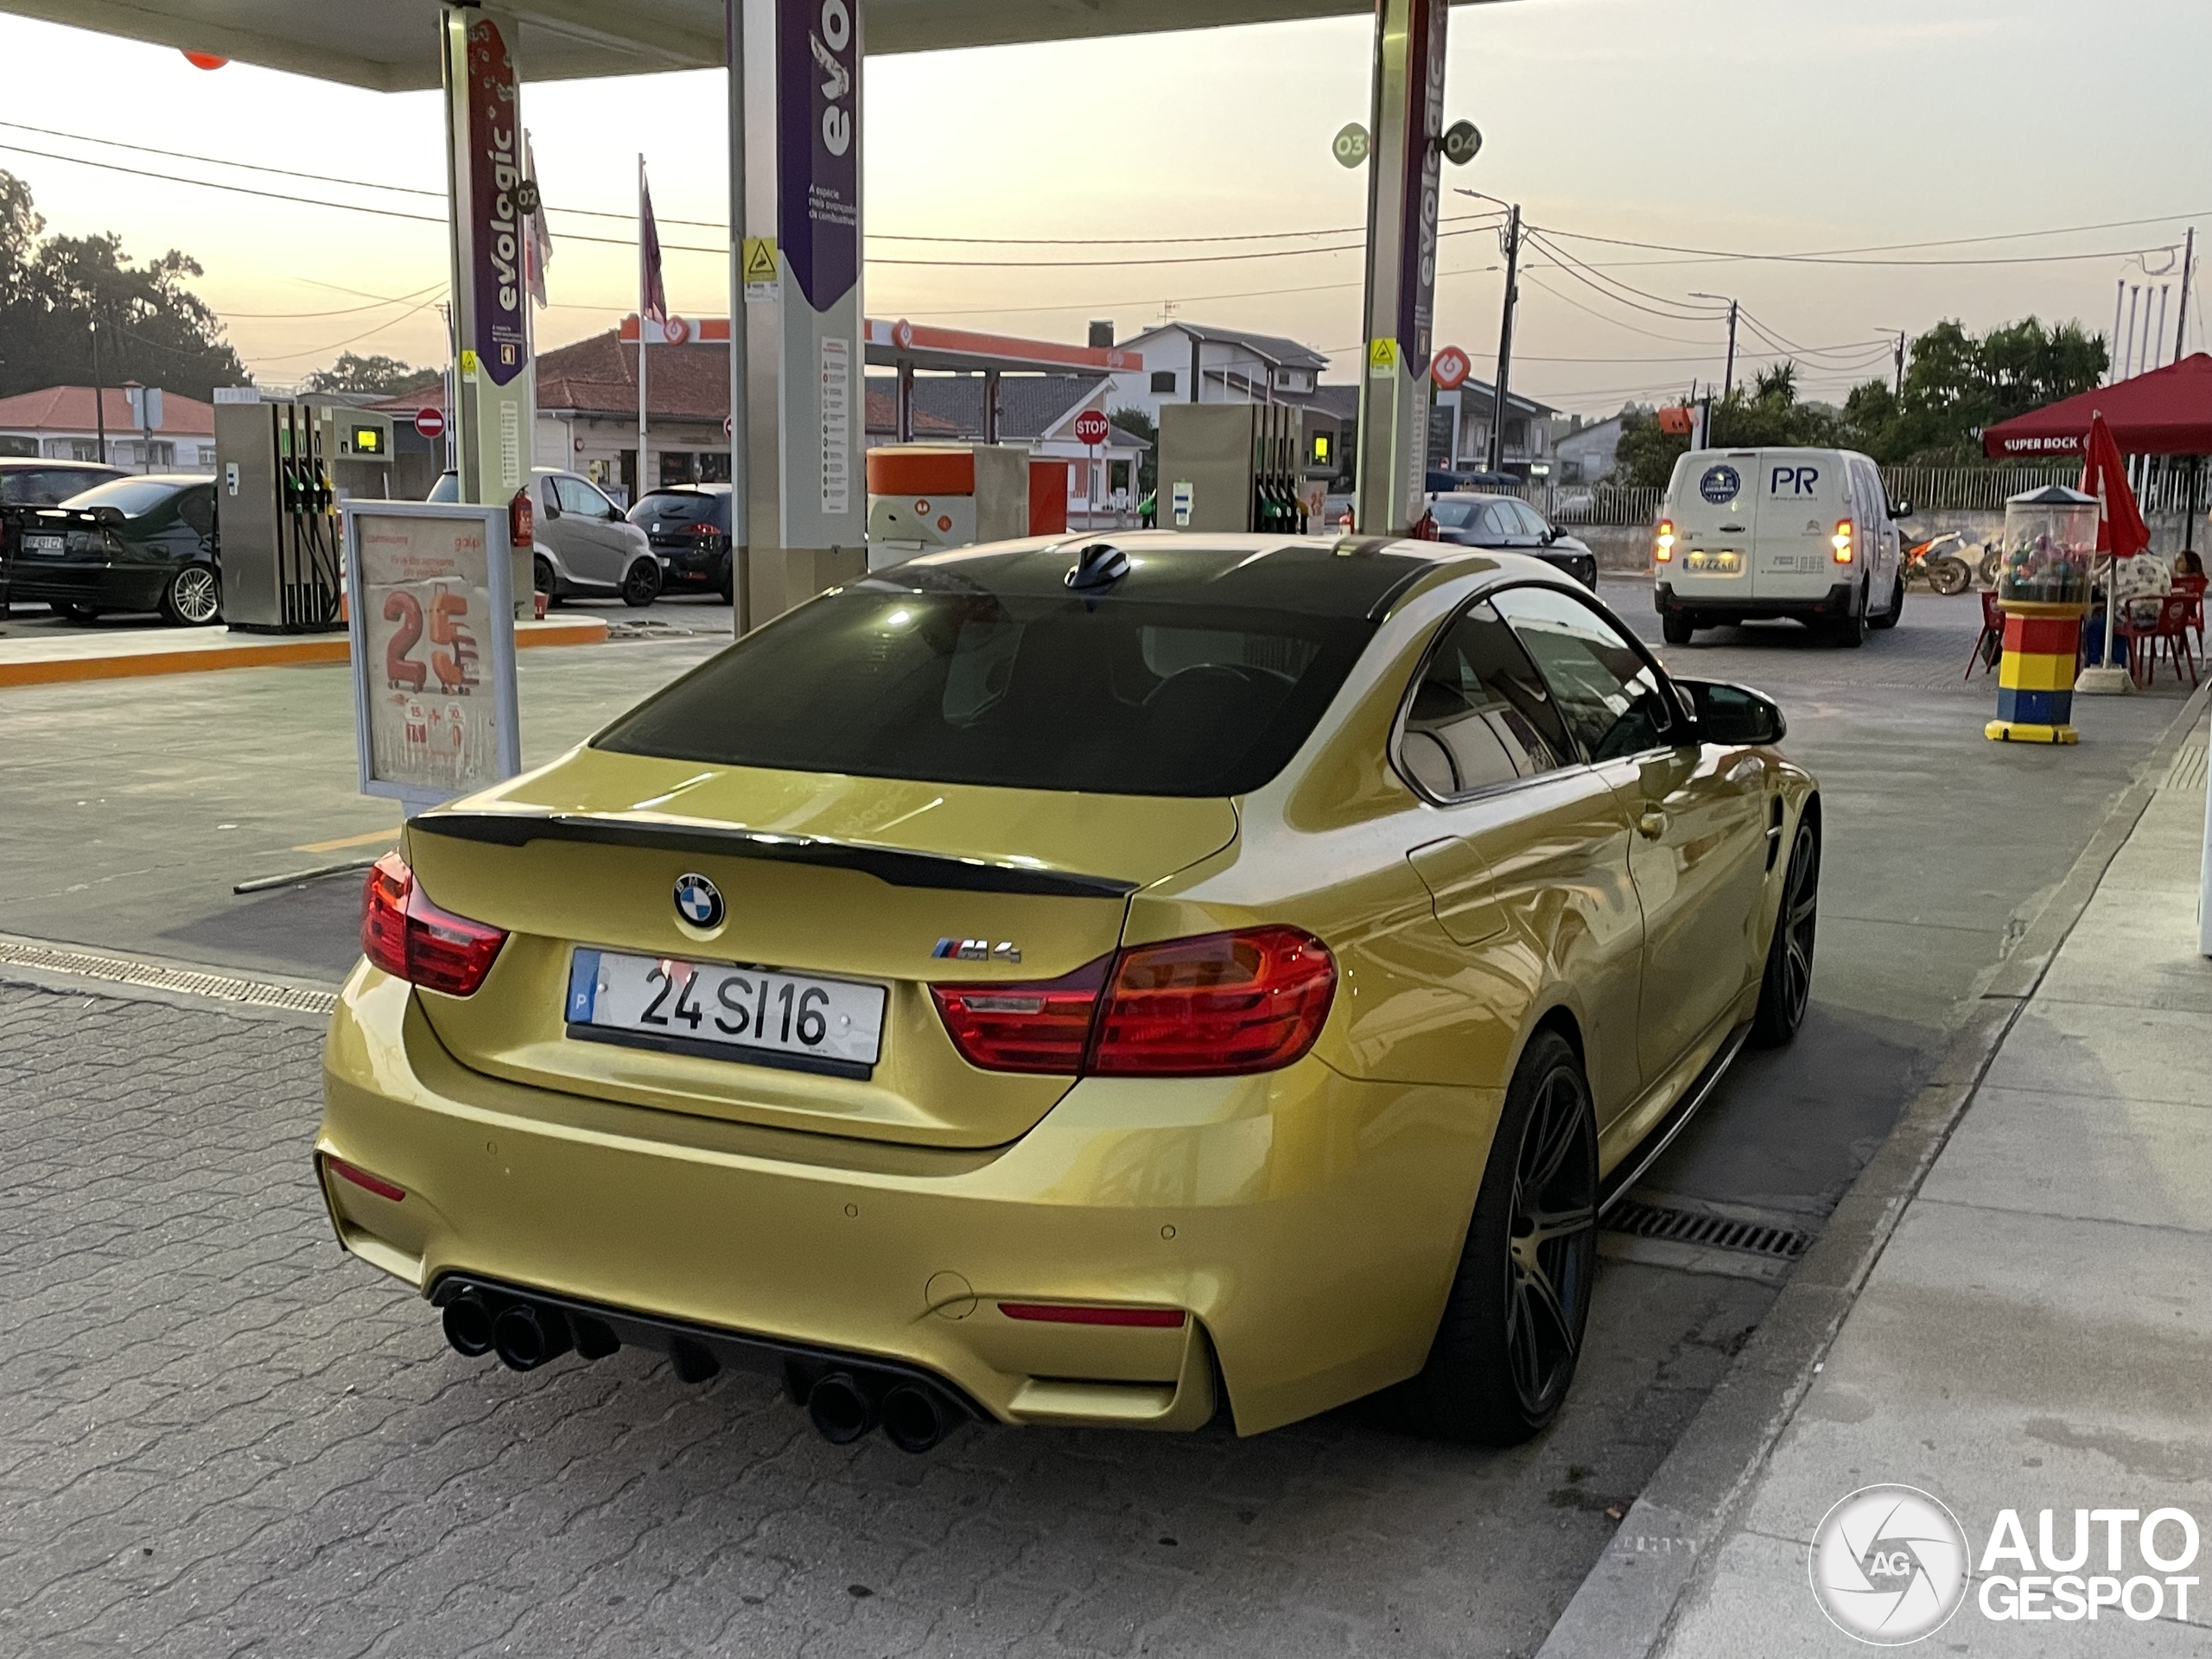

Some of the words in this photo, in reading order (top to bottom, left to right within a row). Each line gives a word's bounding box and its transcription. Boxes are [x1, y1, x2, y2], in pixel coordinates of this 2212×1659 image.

[1335, 133, 1365, 156] 03
[1446, 132, 1478, 154] 04
[518, 188, 538, 206] 02
[487, 126, 519, 312] evologic
[1076, 420, 1108, 435] STOP
[2004, 437, 2042, 452] SUPER
[2044, 436, 2078, 449] BOCK
[1770, 467, 1819, 494] PR
[454, 536, 481, 552] galp
[675, 875, 717, 897] BMW
[956, 938, 1021, 964] M4
[575, 993, 588, 1010] P
[639, 968, 702, 1030] 24
[715, 976, 769, 1040] SI
[778, 982, 830, 1046] 16
